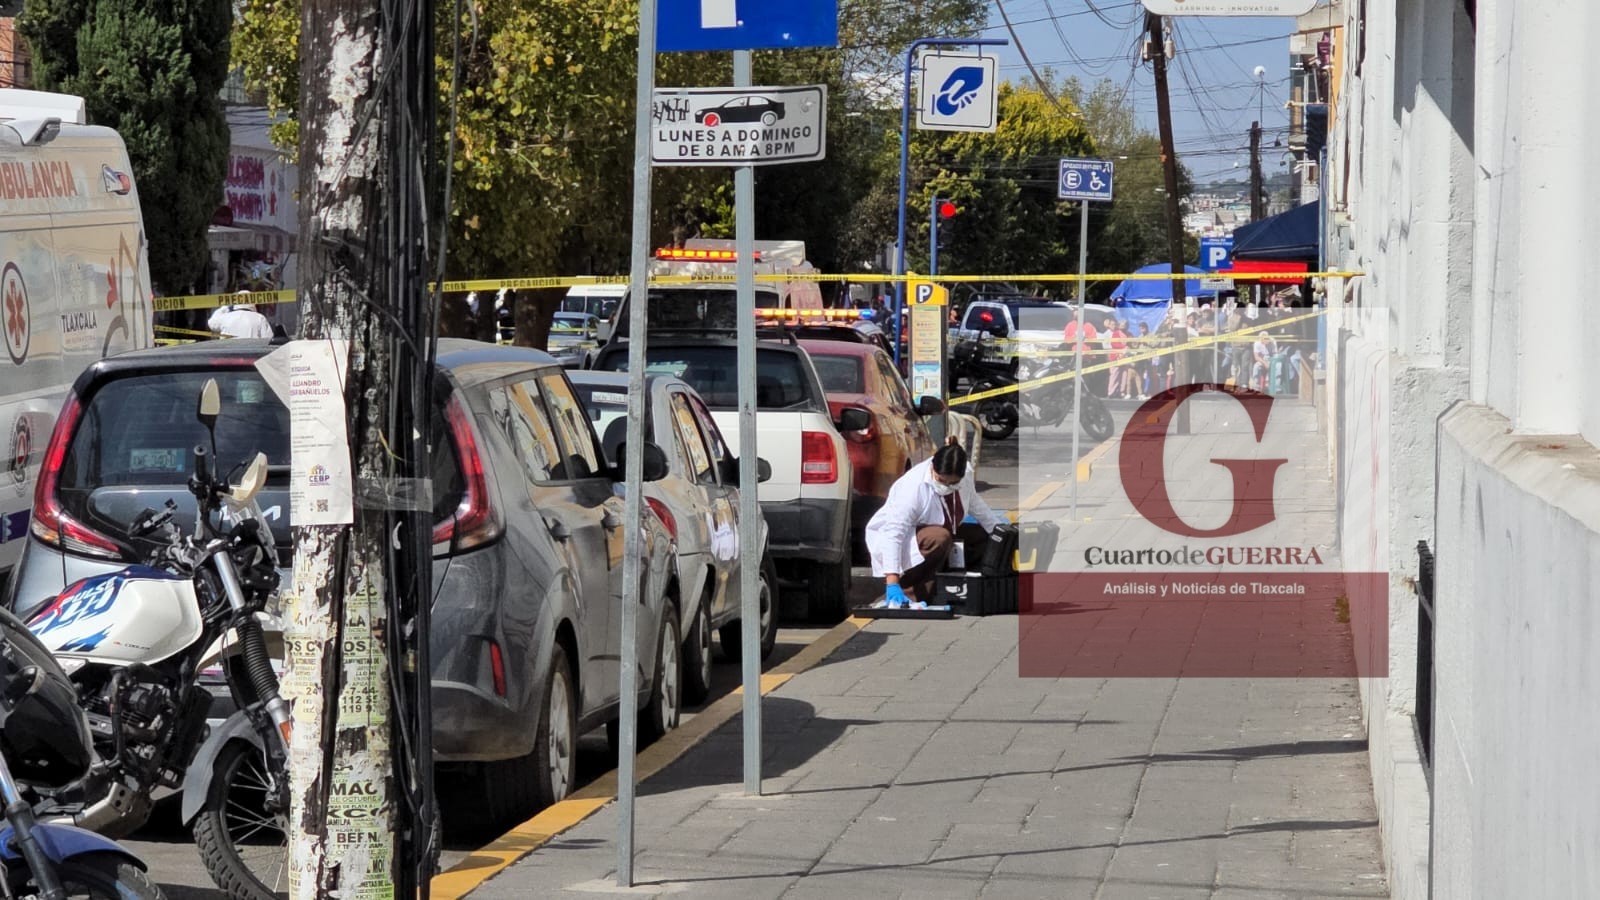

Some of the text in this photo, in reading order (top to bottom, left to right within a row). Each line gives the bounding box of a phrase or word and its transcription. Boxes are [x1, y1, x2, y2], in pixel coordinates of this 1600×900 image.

[658, 125, 812, 142] LUNES A DOMINGO
[678, 144, 699, 156] DE
[706, 144, 714, 156] 8
[720, 144, 745, 157] AM
[750, 143, 760, 156] A
[1066, 172, 1078, 186] E
[1209, 246, 1227, 267] P
[500, 279, 562, 289] PRECAUCION
[218, 292, 280, 305] PRECAUCION
[918, 285, 931, 303] P
[61, 312, 97, 333] TLAXCALA
[308, 475, 330, 483] CEBP
